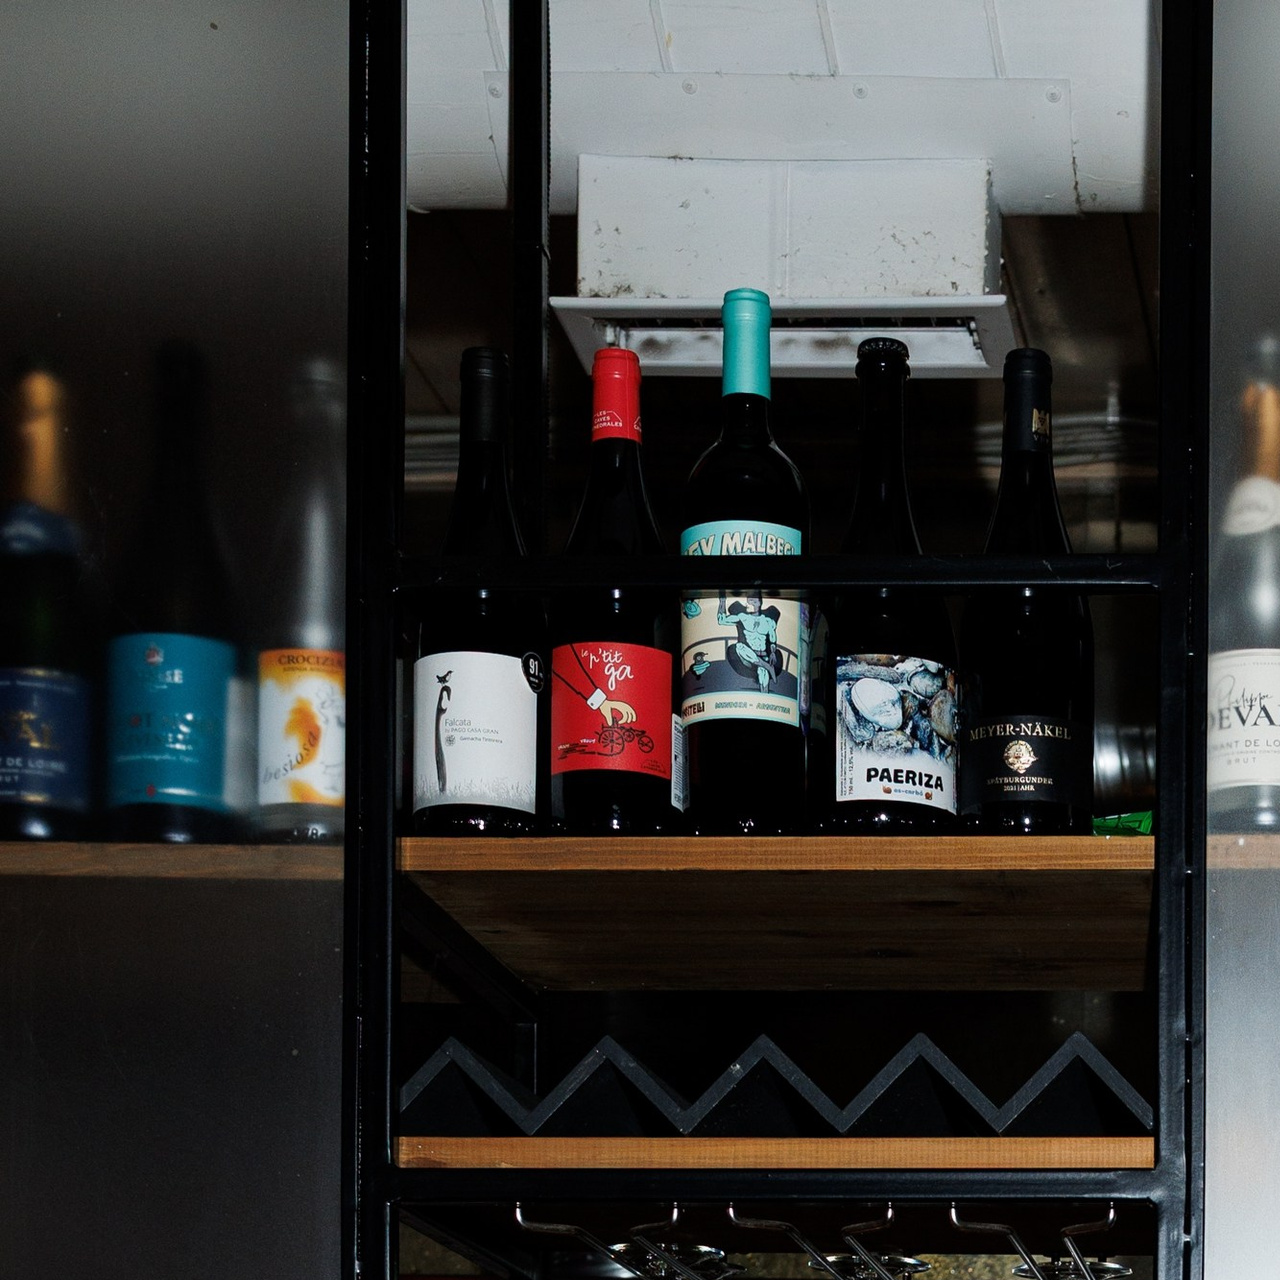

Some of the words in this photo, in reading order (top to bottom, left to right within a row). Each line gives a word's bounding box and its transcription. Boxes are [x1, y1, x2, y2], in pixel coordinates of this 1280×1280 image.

[529, 658, 539, 676] 91
[604, 661, 634, 691] ga
[444, 718, 472, 727] Falcata
[970, 721, 1072, 741] MEYER-NÄKEL
[1244, 739, 1260, 748] DE
[866, 767, 944, 792] PAERIZA
